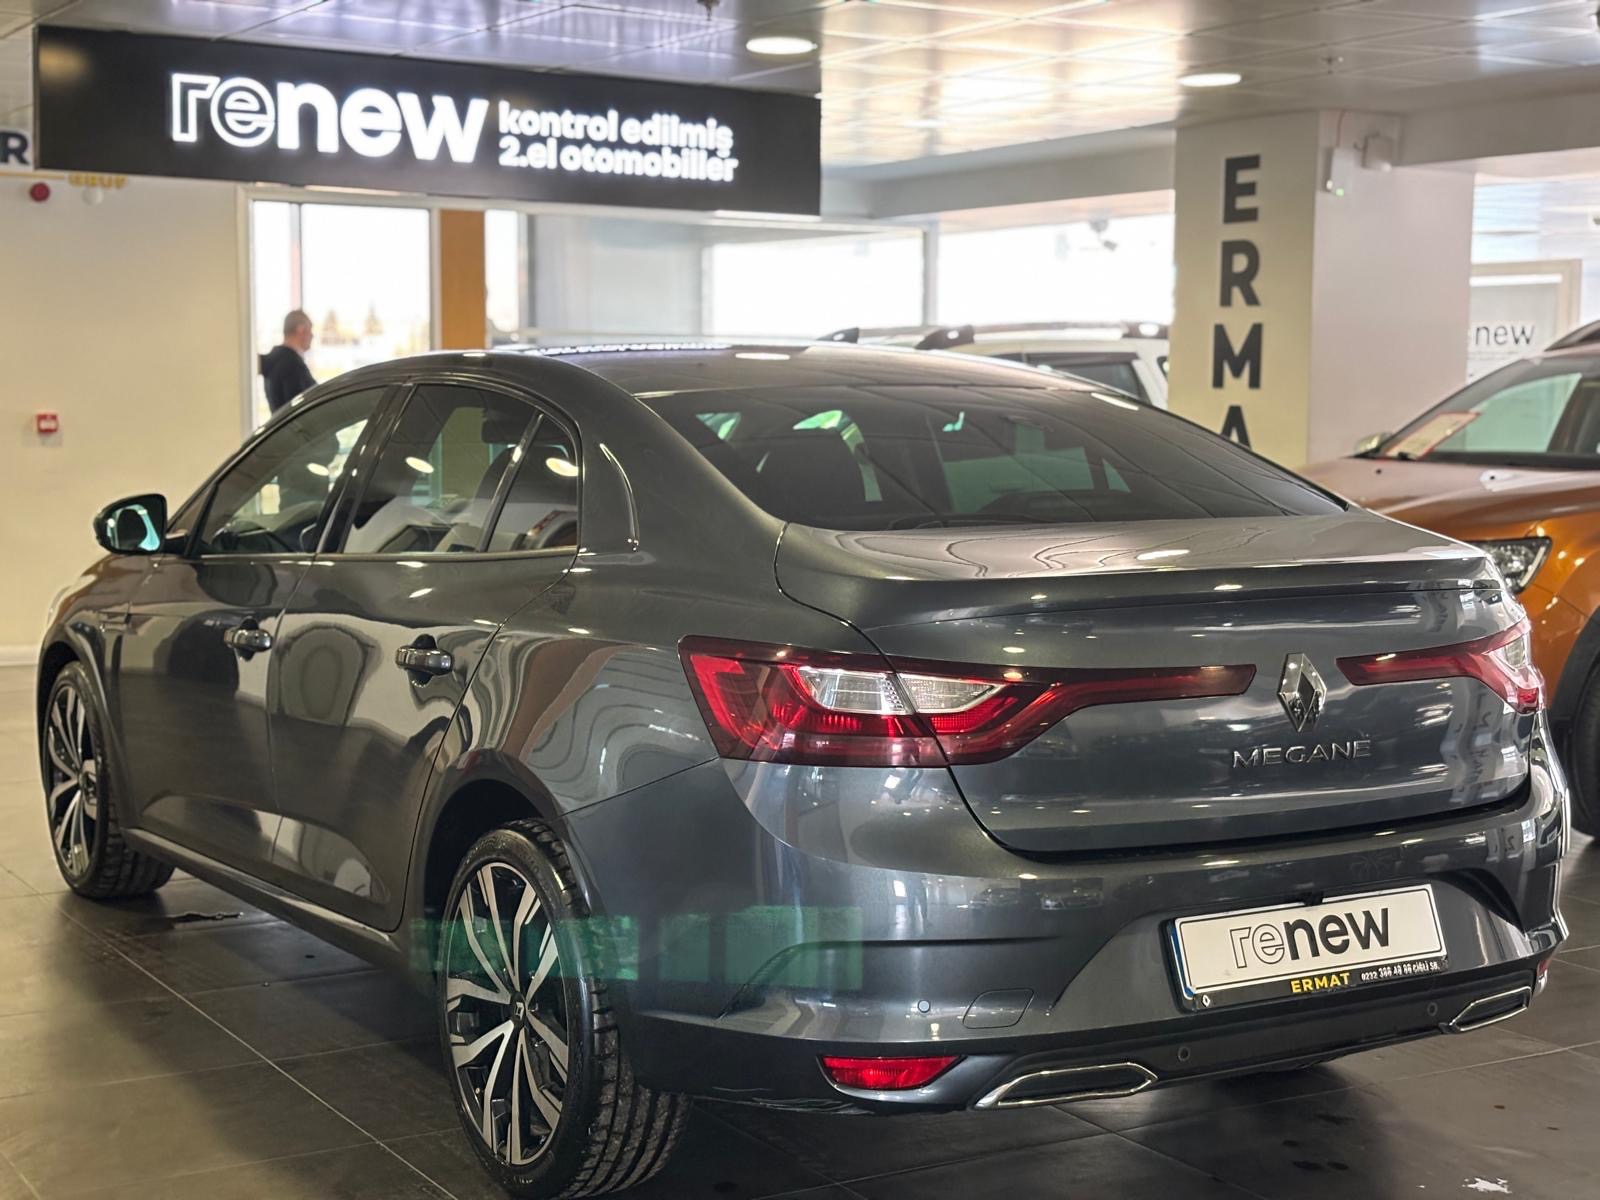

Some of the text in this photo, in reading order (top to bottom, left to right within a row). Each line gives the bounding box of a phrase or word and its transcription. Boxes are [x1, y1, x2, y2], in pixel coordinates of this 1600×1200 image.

[170, 72, 489, 164] renew
[498, 99, 734, 158] kontrol edilmiş
[498, 135, 739, 182] 2.el otomobiller
[1211, 154, 1263, 449] ERMA
[1229, 908, 1390, 969] renew
[1290, 972, 1351, 993] ERMAT
